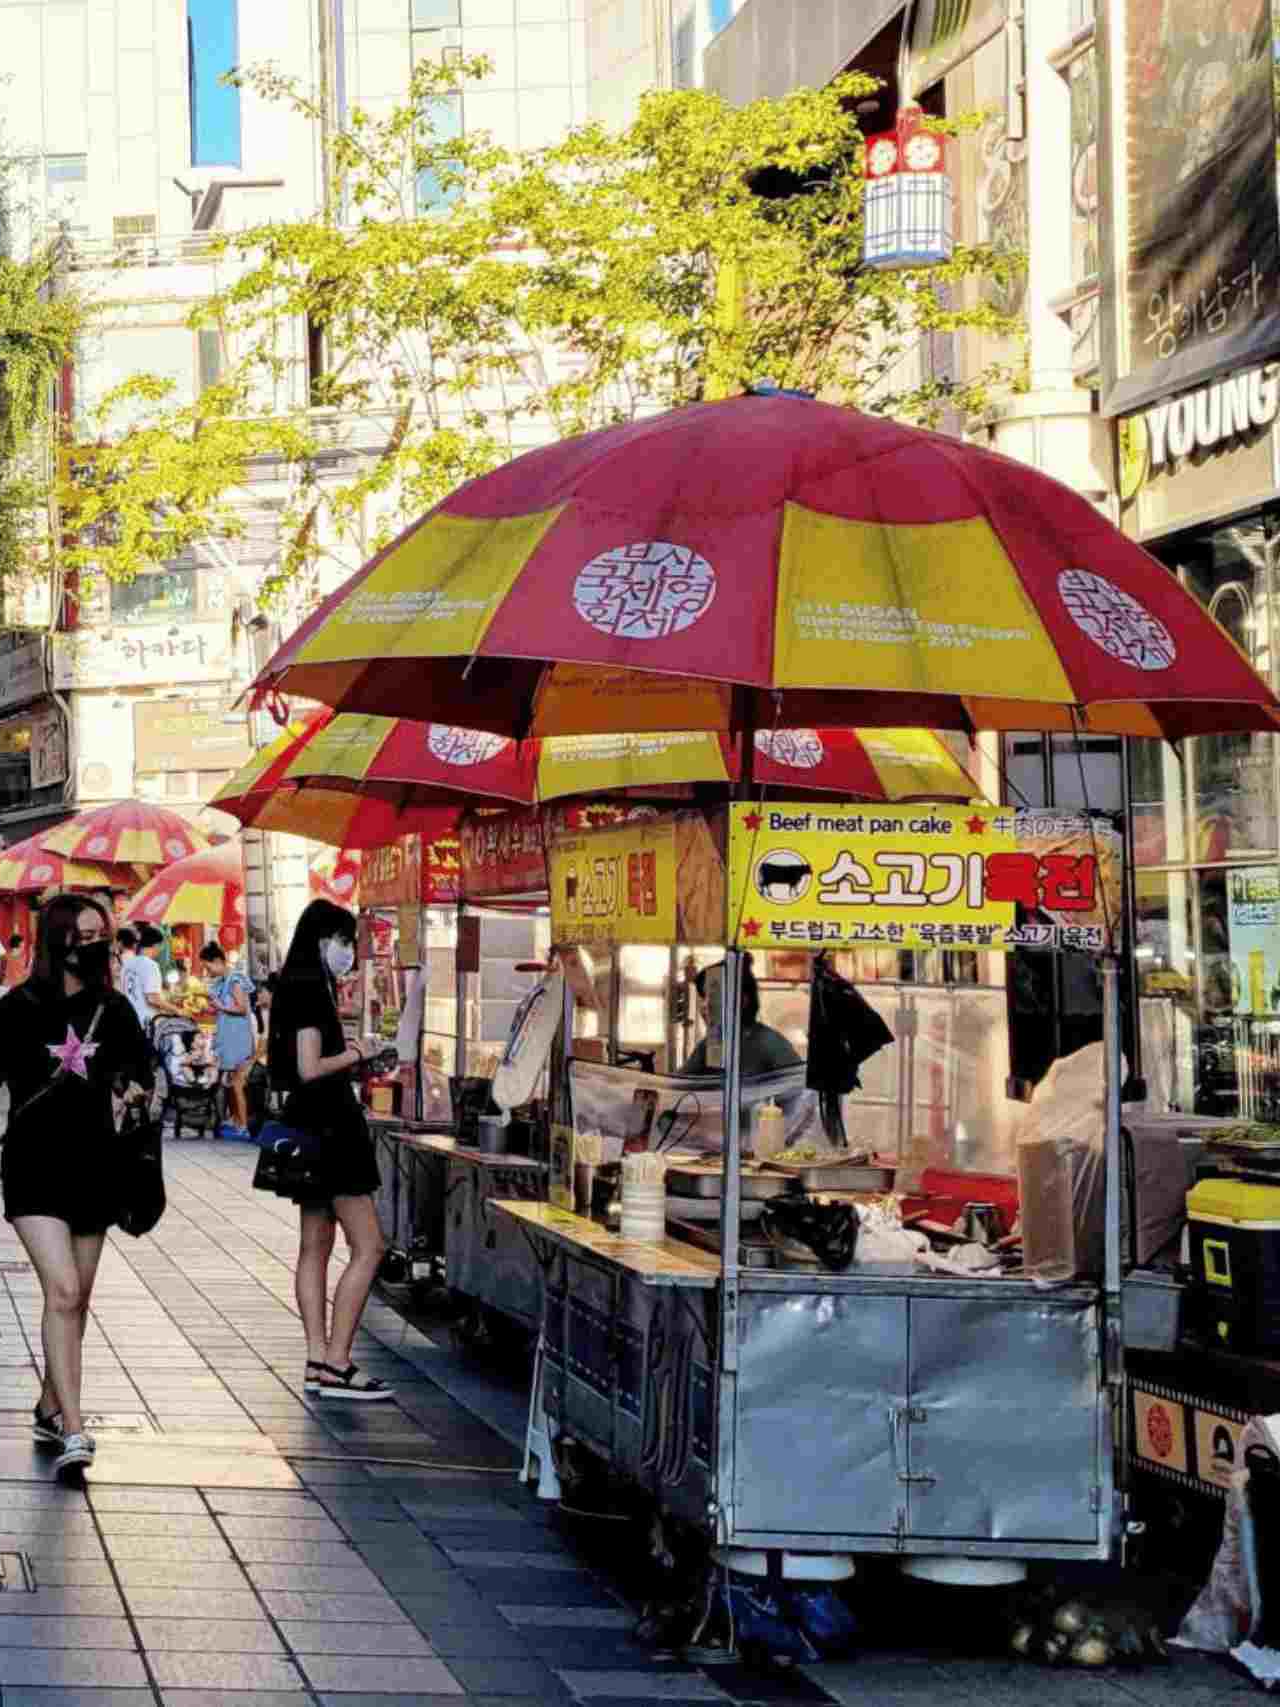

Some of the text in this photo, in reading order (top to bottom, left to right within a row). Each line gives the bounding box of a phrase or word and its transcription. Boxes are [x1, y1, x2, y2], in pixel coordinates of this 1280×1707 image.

[768, 812, 953, 835] Beef meat pan cake
[769, 920, 842, 943] 부드럽고
[851, 923, 904, 944] 고소한
[1004, 925, 1057, 948] 소고기
